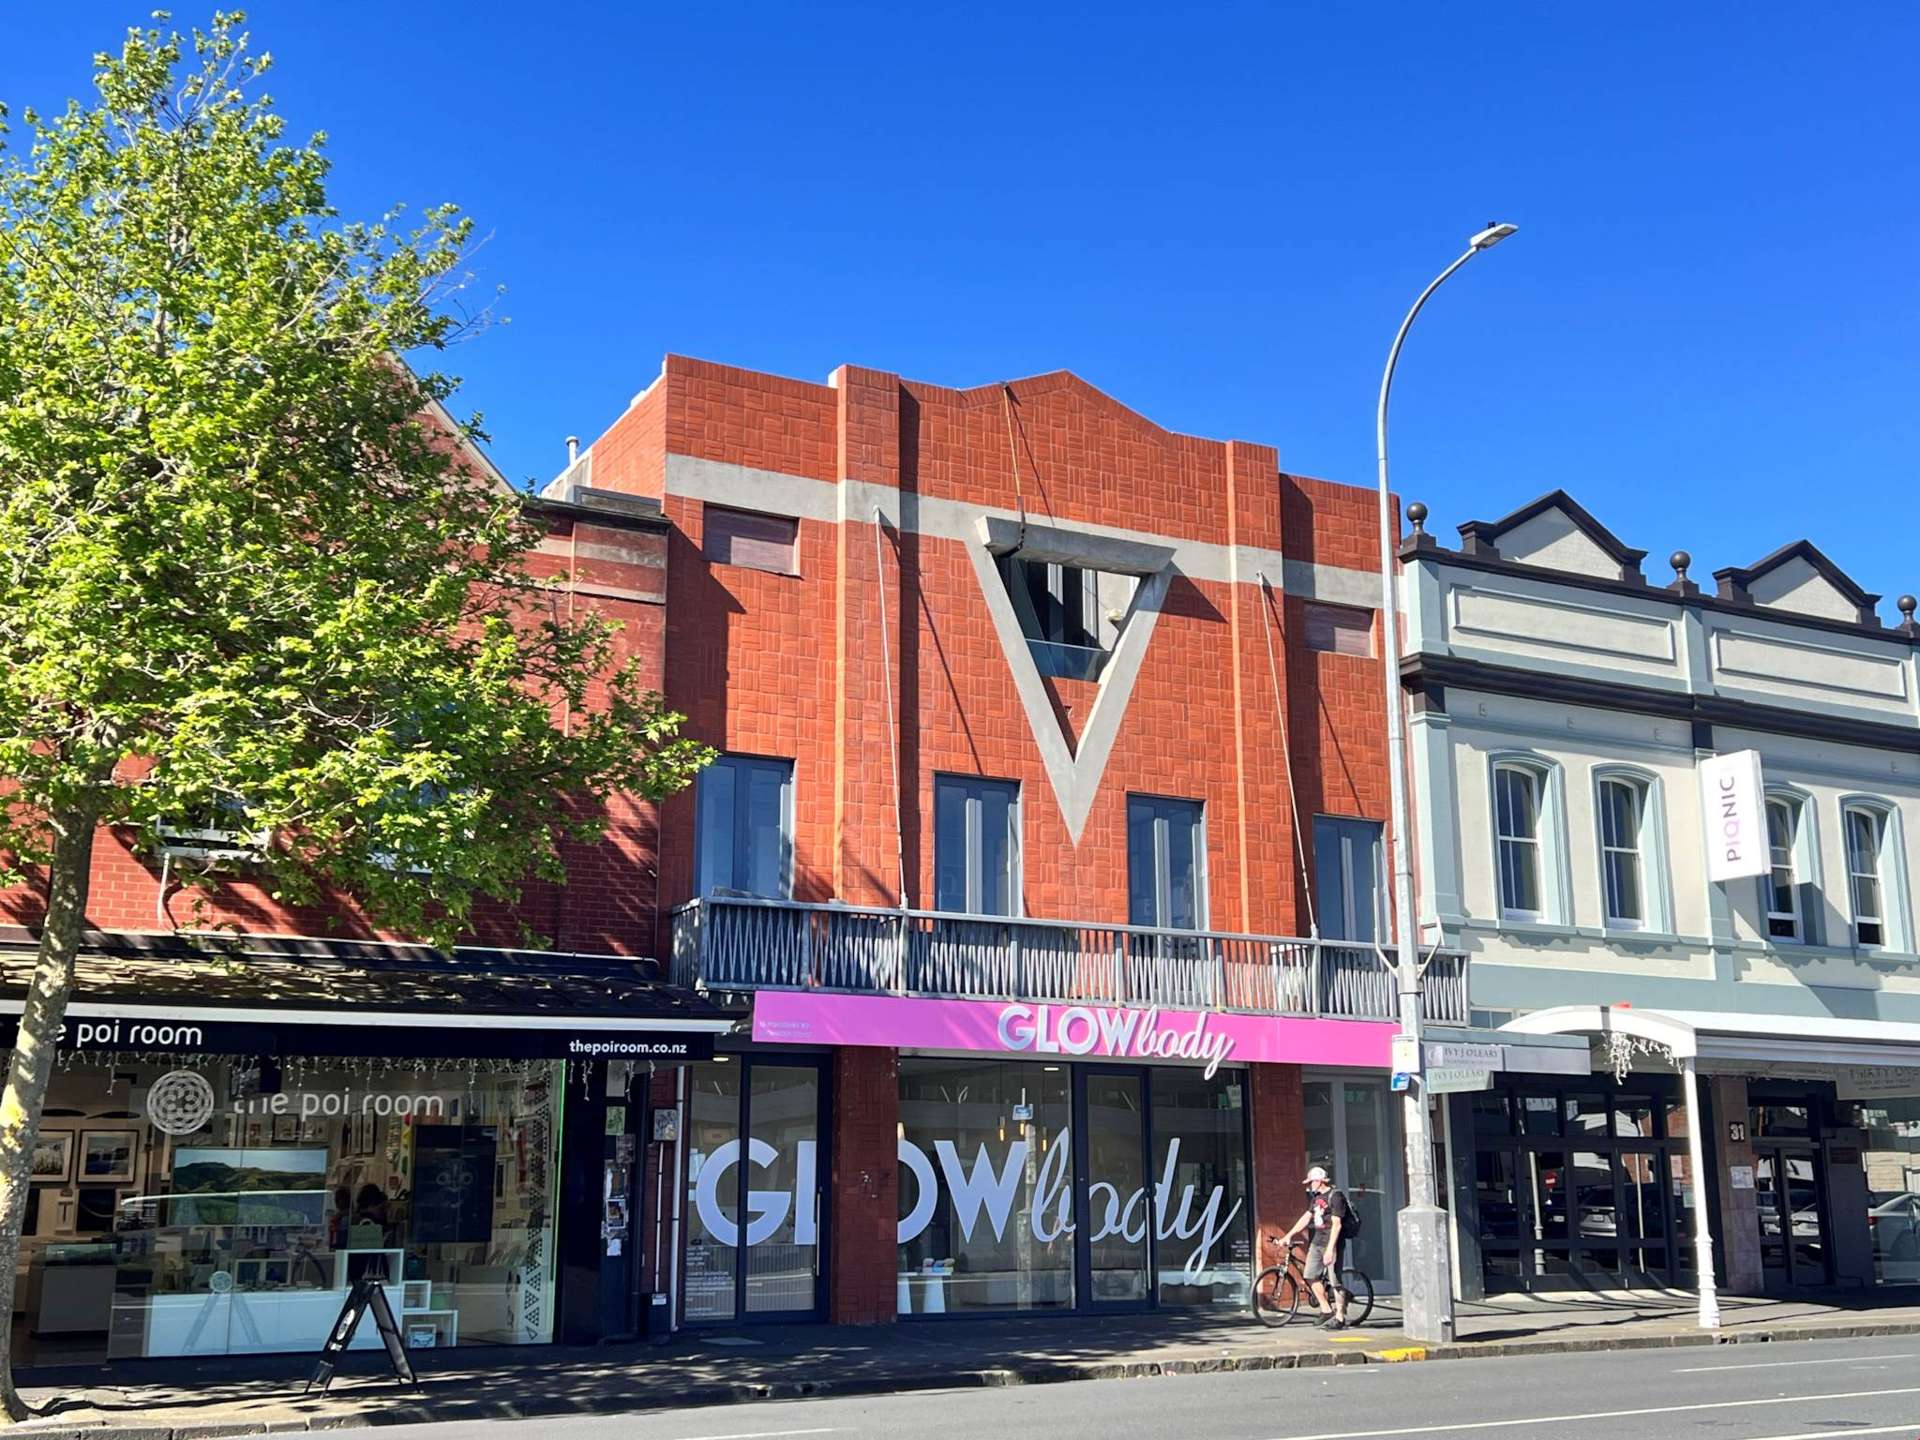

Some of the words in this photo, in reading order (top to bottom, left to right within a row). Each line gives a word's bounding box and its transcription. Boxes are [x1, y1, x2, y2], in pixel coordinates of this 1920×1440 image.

[1719, 776, 1741, 861] PIQNIC
[76, 1019, 121, 1048] poi
[129, 1025, 202, 1045] room
[569, 1039, 688, 1056] thepoiroom.co.nz
[997, 1004, 1234, 1080] GLOWbody
[302, 1087, 349, 1121] poi
[362, 1094, 443, 1116] room
[1730, 1123, 1745, 1140] 31
